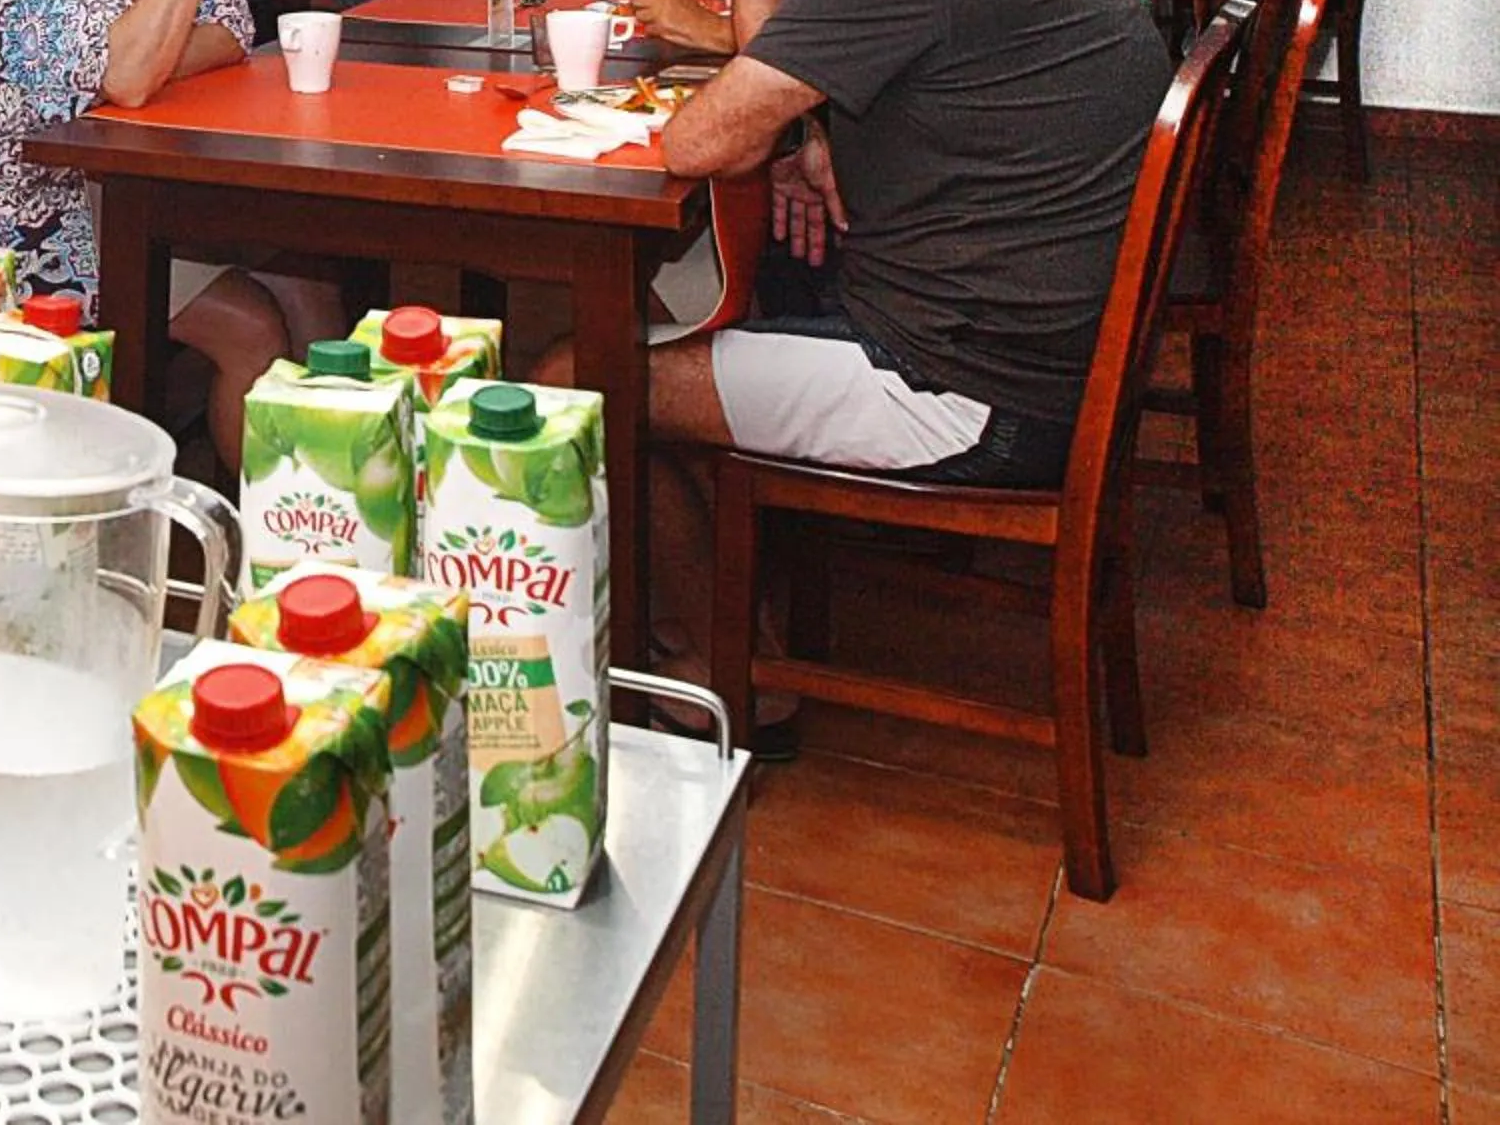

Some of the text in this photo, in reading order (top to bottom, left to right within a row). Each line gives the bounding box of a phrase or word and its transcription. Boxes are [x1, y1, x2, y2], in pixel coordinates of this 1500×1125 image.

[468, 661, 529, 688] 00%
[167, 1004, 269, 1055] Clássico
[253, 1068, 289, 1089] DO
